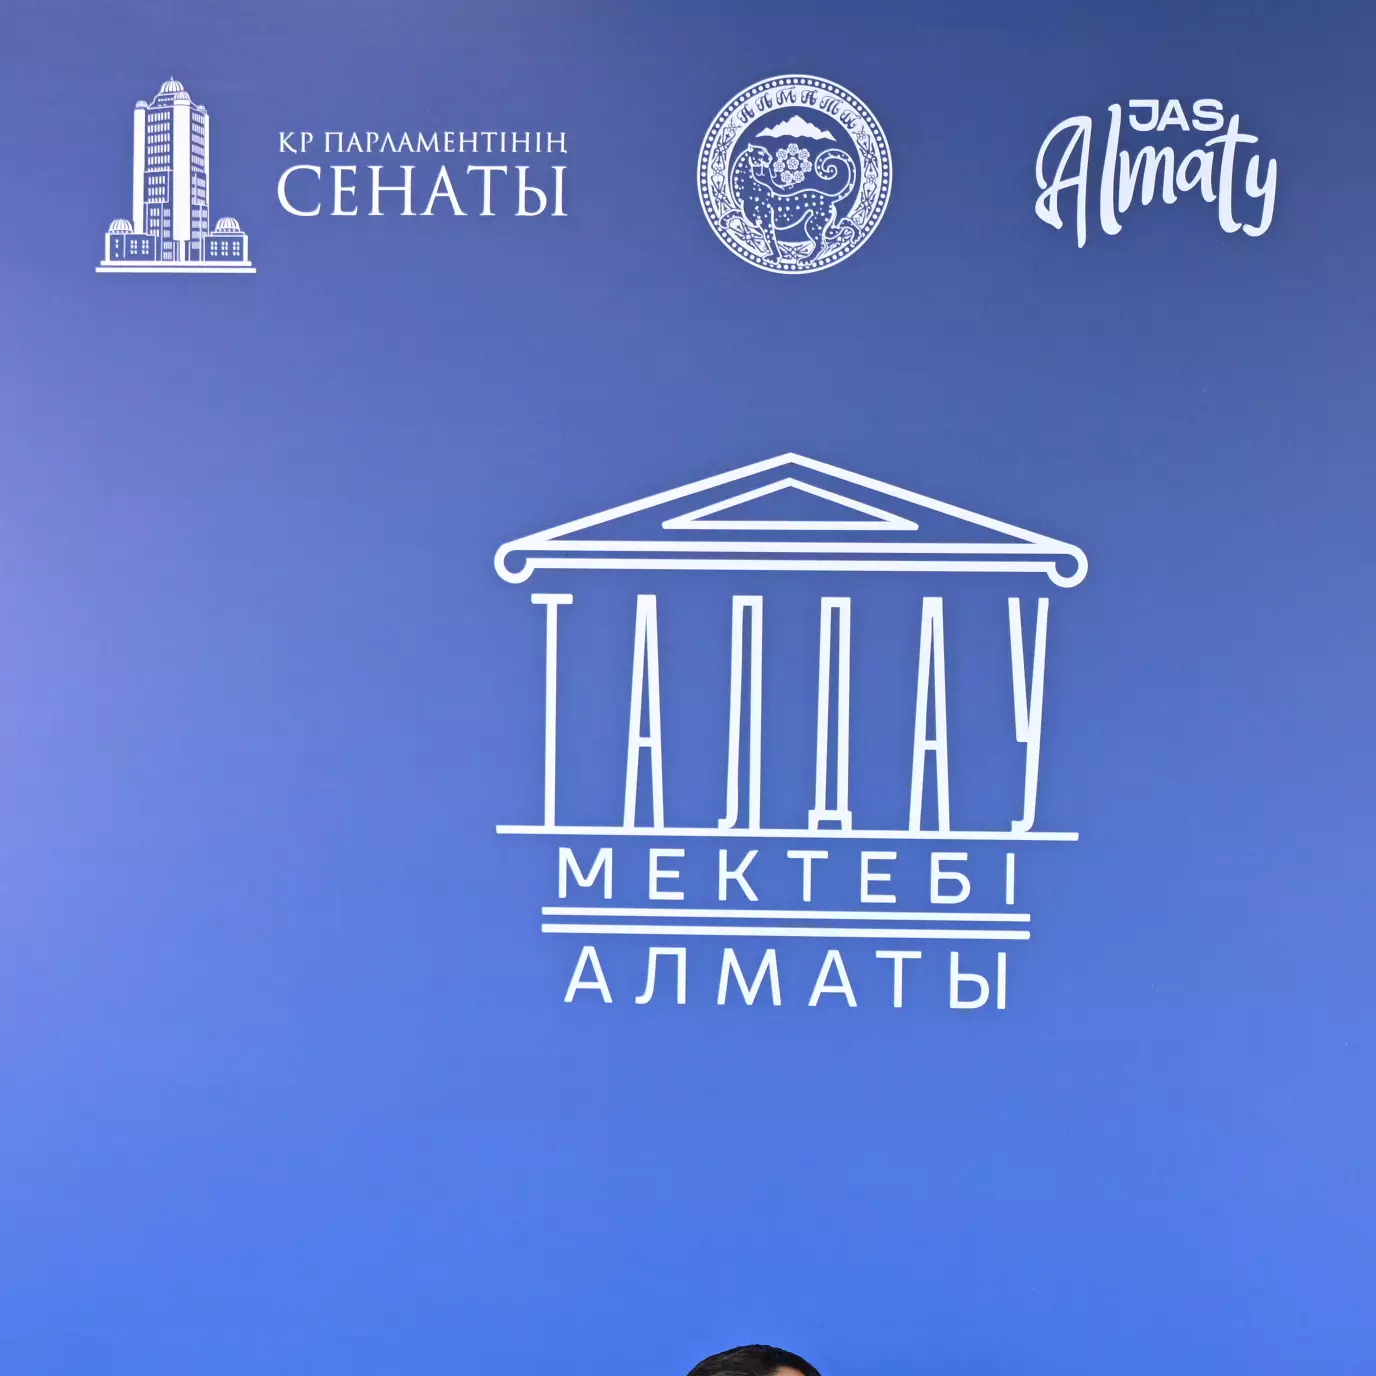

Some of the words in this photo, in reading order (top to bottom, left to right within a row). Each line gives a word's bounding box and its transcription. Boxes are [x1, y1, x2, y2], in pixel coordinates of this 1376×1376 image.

[278, 131, 314, 155] ҚР
[324, 131, 568, 154] ПАРЛАМЕНТІНІҢ
[1128, 98, 1225, 132] JAS
[277, 164, 567, 217] СЕНАТЫ
[1034, 103, 1278, 249] Almaty
[530, 593, 1050, 833] ТАЛДАУ
[557, 847, 1016, 906] МЕКТЕБІ
[563, 945, 1008, 1011] АЛМАТЫ
